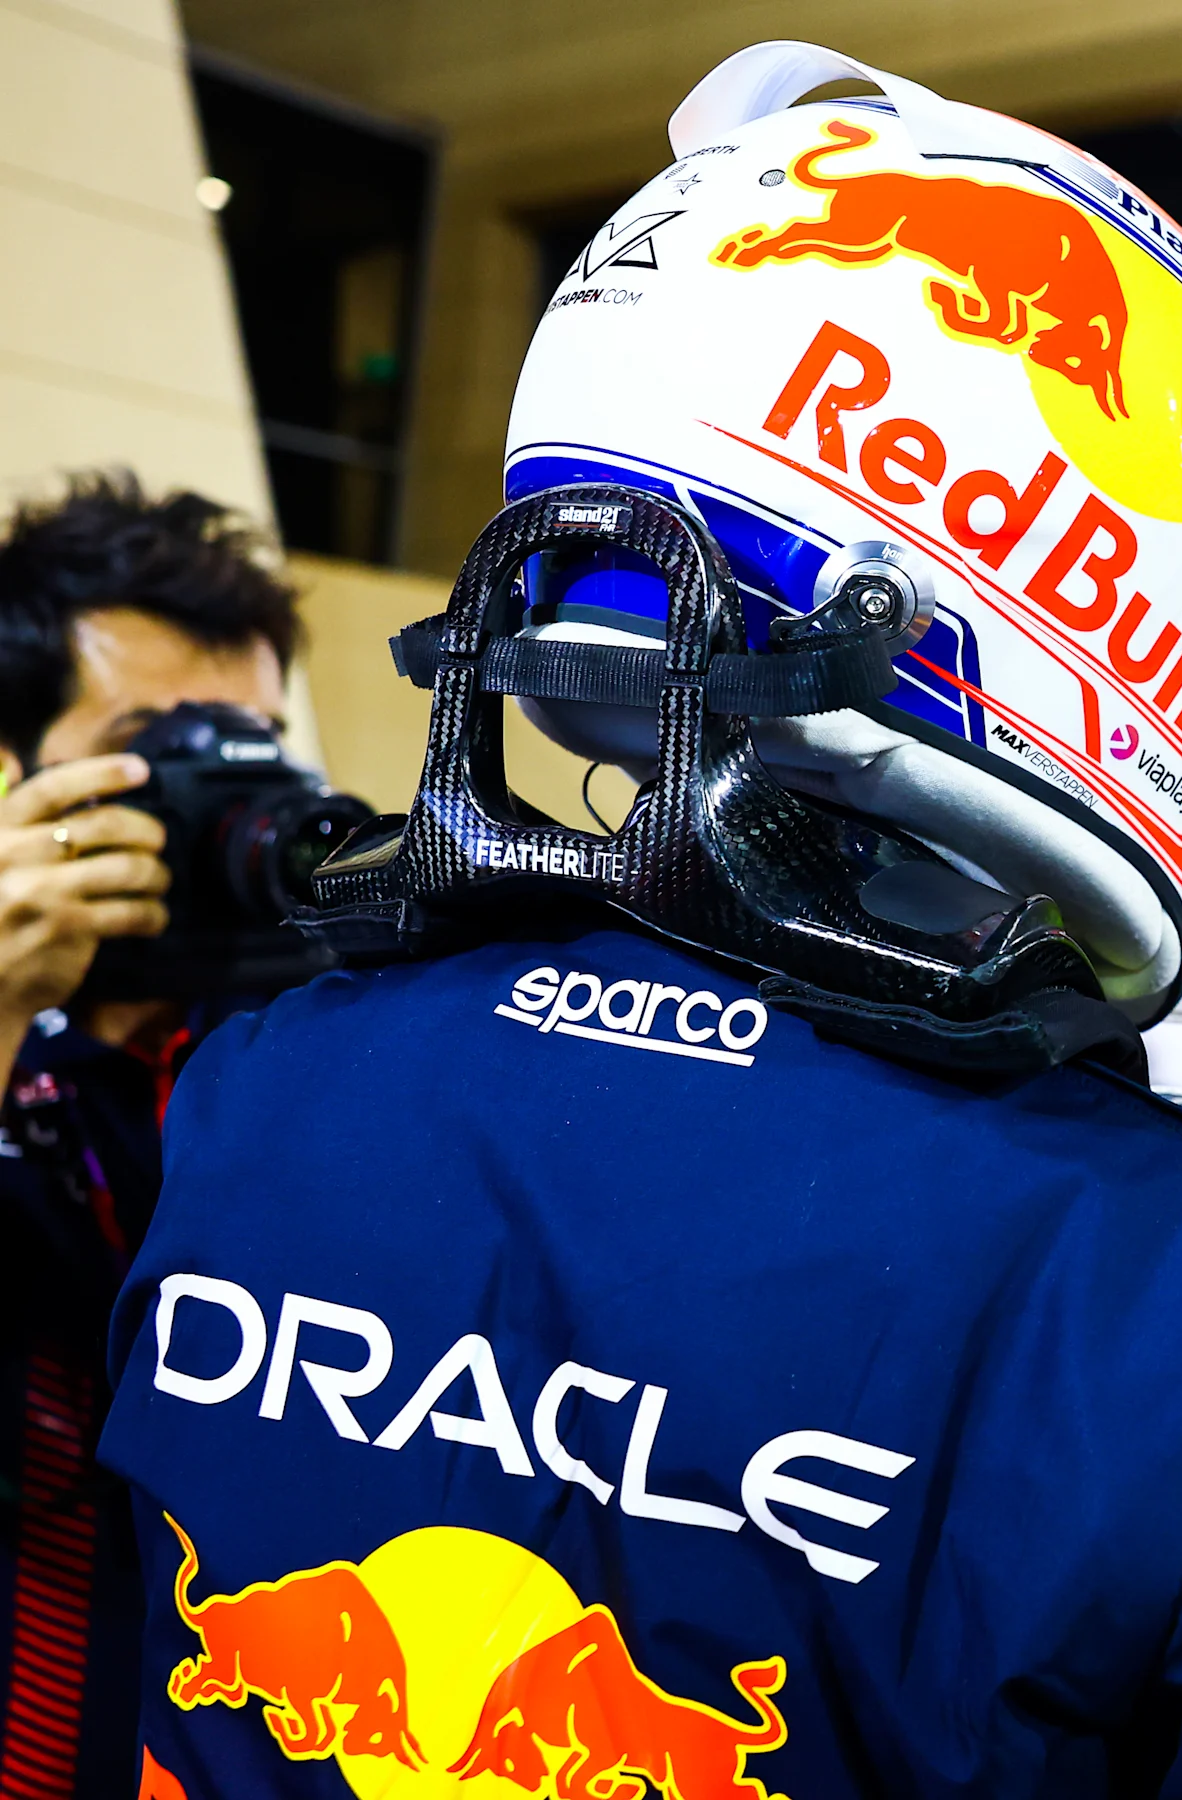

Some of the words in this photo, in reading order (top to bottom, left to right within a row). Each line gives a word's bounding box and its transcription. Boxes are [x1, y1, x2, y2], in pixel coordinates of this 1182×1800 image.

[762, 320, 1068, 571] Red
[558, 506, 619, 524] stand21
[476, 838, 625, 883] FEATHERLITE
[510, 965, 768, 1051] sparco
[153, 1273, 917, 1585] ORACLE
